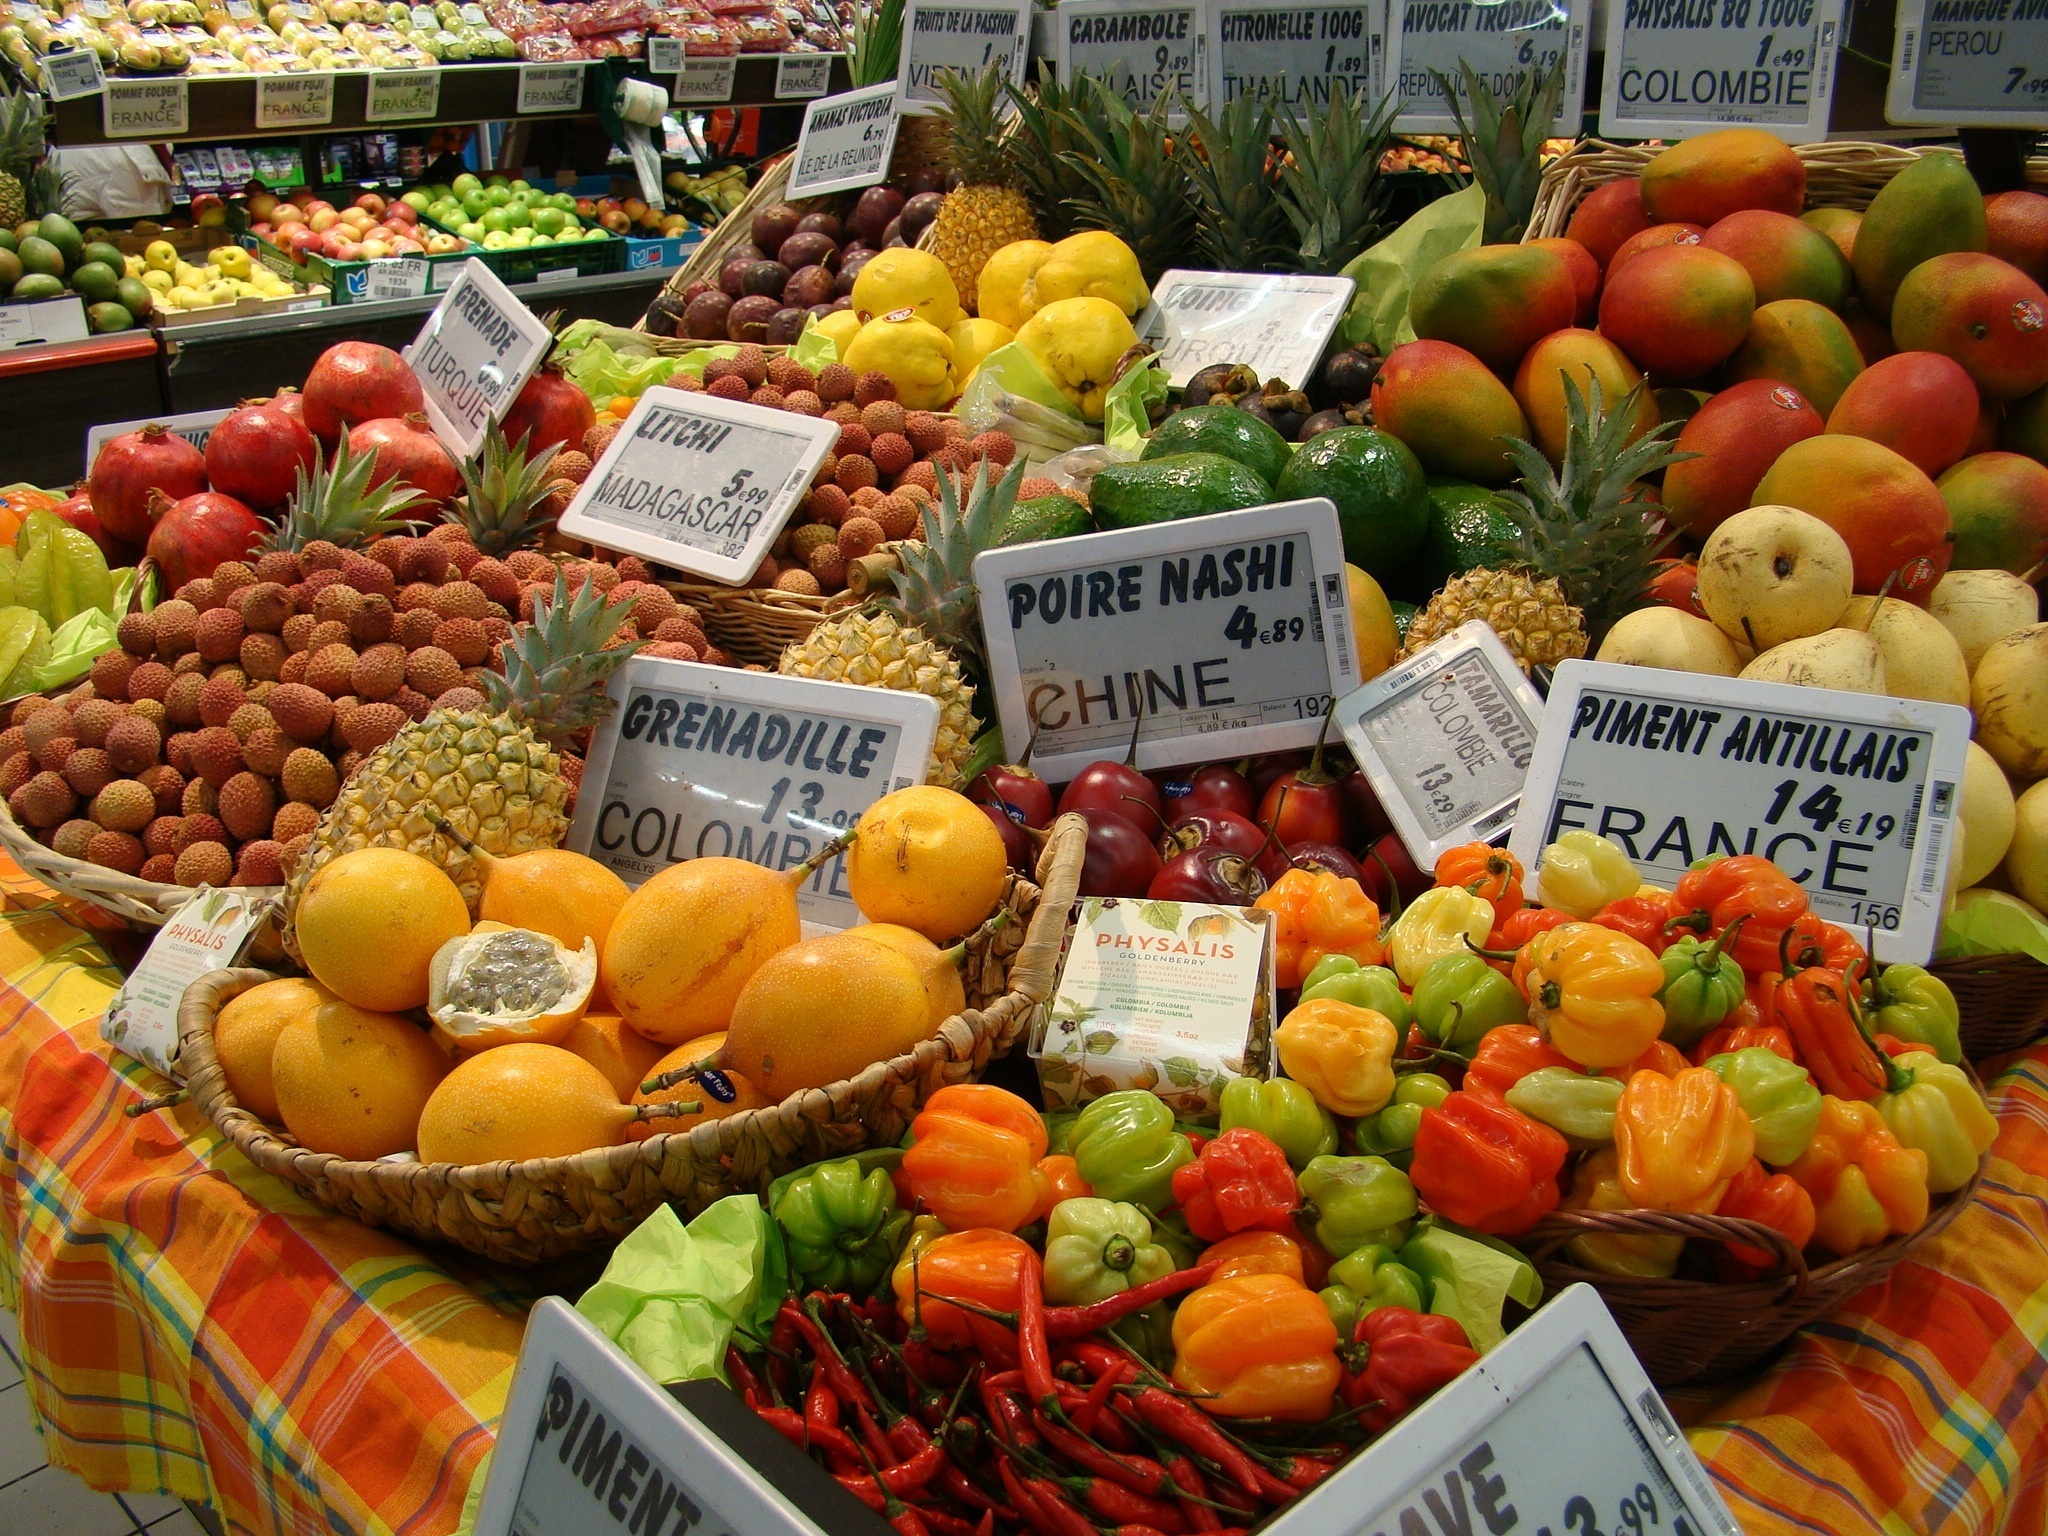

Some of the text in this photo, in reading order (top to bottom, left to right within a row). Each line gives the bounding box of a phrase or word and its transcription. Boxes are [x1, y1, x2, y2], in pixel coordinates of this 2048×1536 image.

[914, 10, 1016, 35] FRUITS DE LA PASSION
[1070, 12, 1189, 44] CARAMBOLE
[1221, 10, 1363, 41] CITRONELLE 100G
[1403, 4, 1472, 33] AVOCAT
[1626, 0, 1813, 29] PHYSALIS BQ 100G
[1928, 31, 2003, 55] PEROU
[111, 86, 178, 100] POMME GOLDEN
[264, 81, 301, 93] POMME
[524, 90, 572, 102] FRANCE
[680, 82, 724, 92] FRANCE
[781, 78, 820, 88] FRANCE
[1620, 69, 1810, 105] COLOMBIE
[112, 110, 175, 124] FRANCE
[263, 102, 320, 116] FRANCE
[373, 98, 427, 111] FRANCE
[808, 97, 893, 134] ANANAS VICTORIA
[814, 156, 827, 172] DE
[828, 153, 839, 169] LA
[841, 143, 885, 167] REUNION
[407, 260, 422, 271] FR
[454, 283, 519, 357] GRENADE
[420, 335, 494, 429] TURQUIE
[636, 410, 733, 454] LITCHI
[595, 473, 763, 543] MADAGASCAR
[1008, 541, 1295, 630] POIRE NASHI
[1027, 657, 1236, 731] CHINE
[1293, 694, 1332, 720] 192
[622, 694, 887, 778] GRENADILLE
[1420, 681, 1498, 777] COLOMBIE
[1570, 695, 1920, 783] PIMENT ANTILLAIS
[1560, 778, 1585, 788] Calibre
[1546, 798, 1876, 896] FRANCE
[610, 857, 656, 874] ANGELYS
[1850, 901, 1900, 930] 156
[167, 923, 228, 950] PHYSALIS
[1096, 933, 1235, 959] PHYSALIS
[1119, 952, 1206, 967] GOLDENBERRY
[1110, 1004, 1148, 1013] KOLUMBIEN
[1154, 1009, 1193, 1018] KOLUMBIJA
[1116, 997, 1150, 1006] COLOMBIA
[1156, 1002, 1190, 1011] COLOMBIE
[537, 1375, 703, 1536] PIMENT
